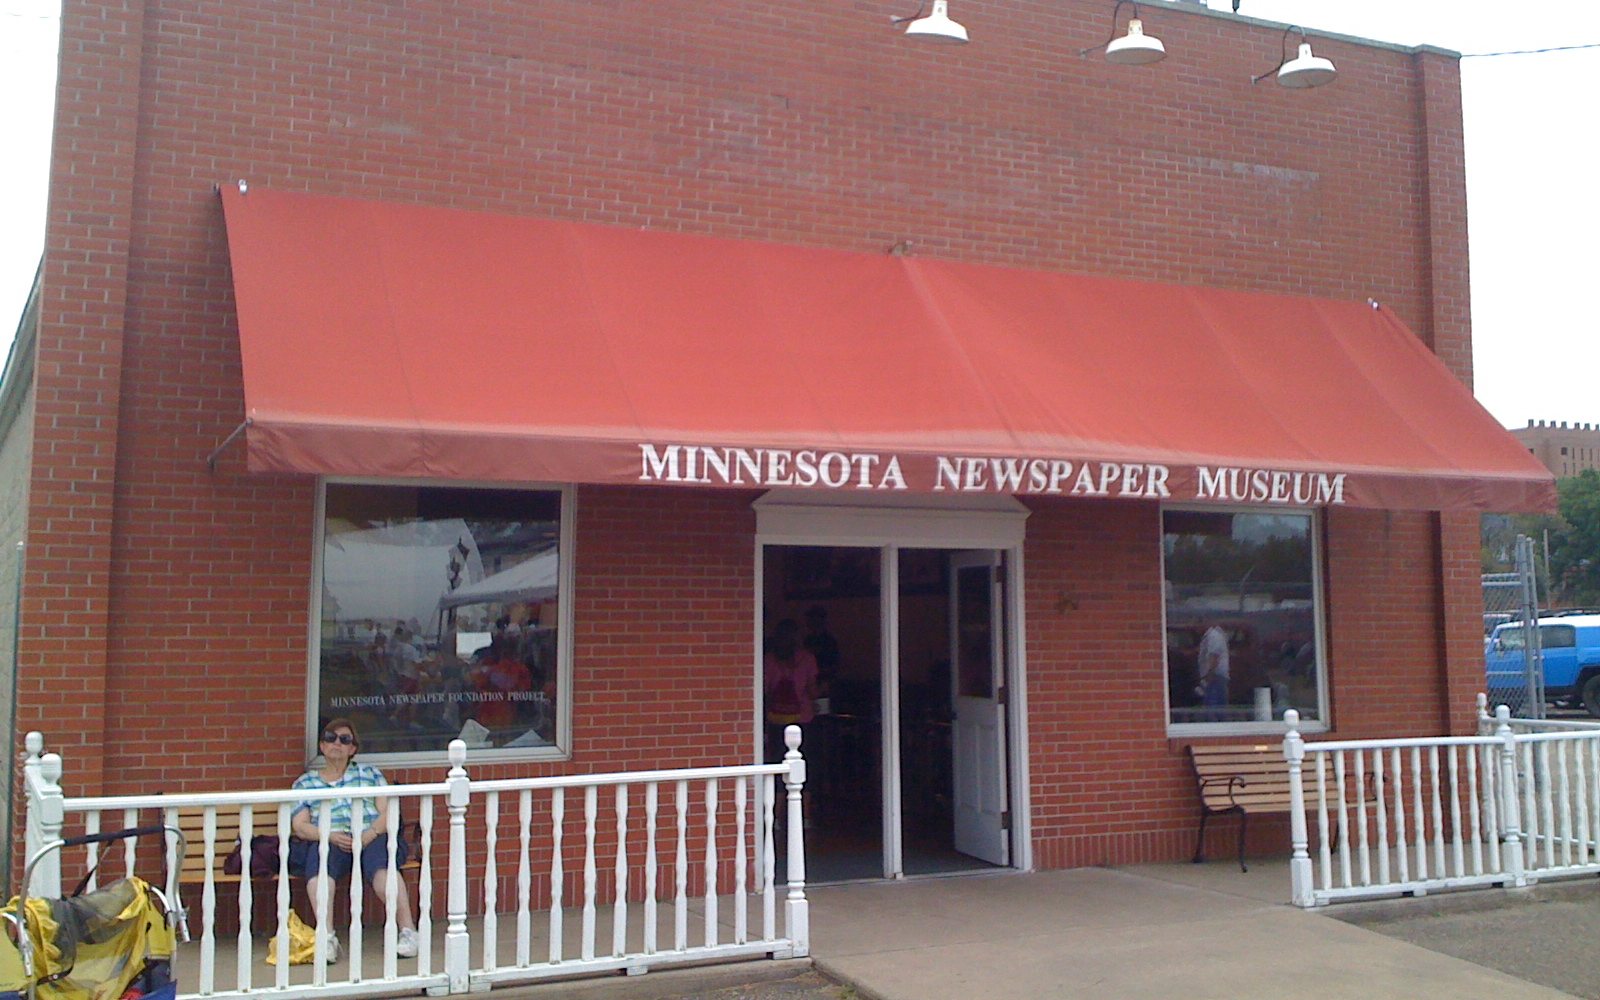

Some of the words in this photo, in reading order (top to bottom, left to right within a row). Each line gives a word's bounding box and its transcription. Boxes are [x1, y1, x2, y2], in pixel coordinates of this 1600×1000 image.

[638, 443, 908, 491] MINNESOTA
[933, 456, 1171, 498] NEWSPAPER
[1196, 466, 1347, 504] MUSEUM
[330, 695, 386, 708] MINNESOTA
[388, 692, 445, 705] NEWSPAPER
[448, 691, 504, 703] FOUNDATION
